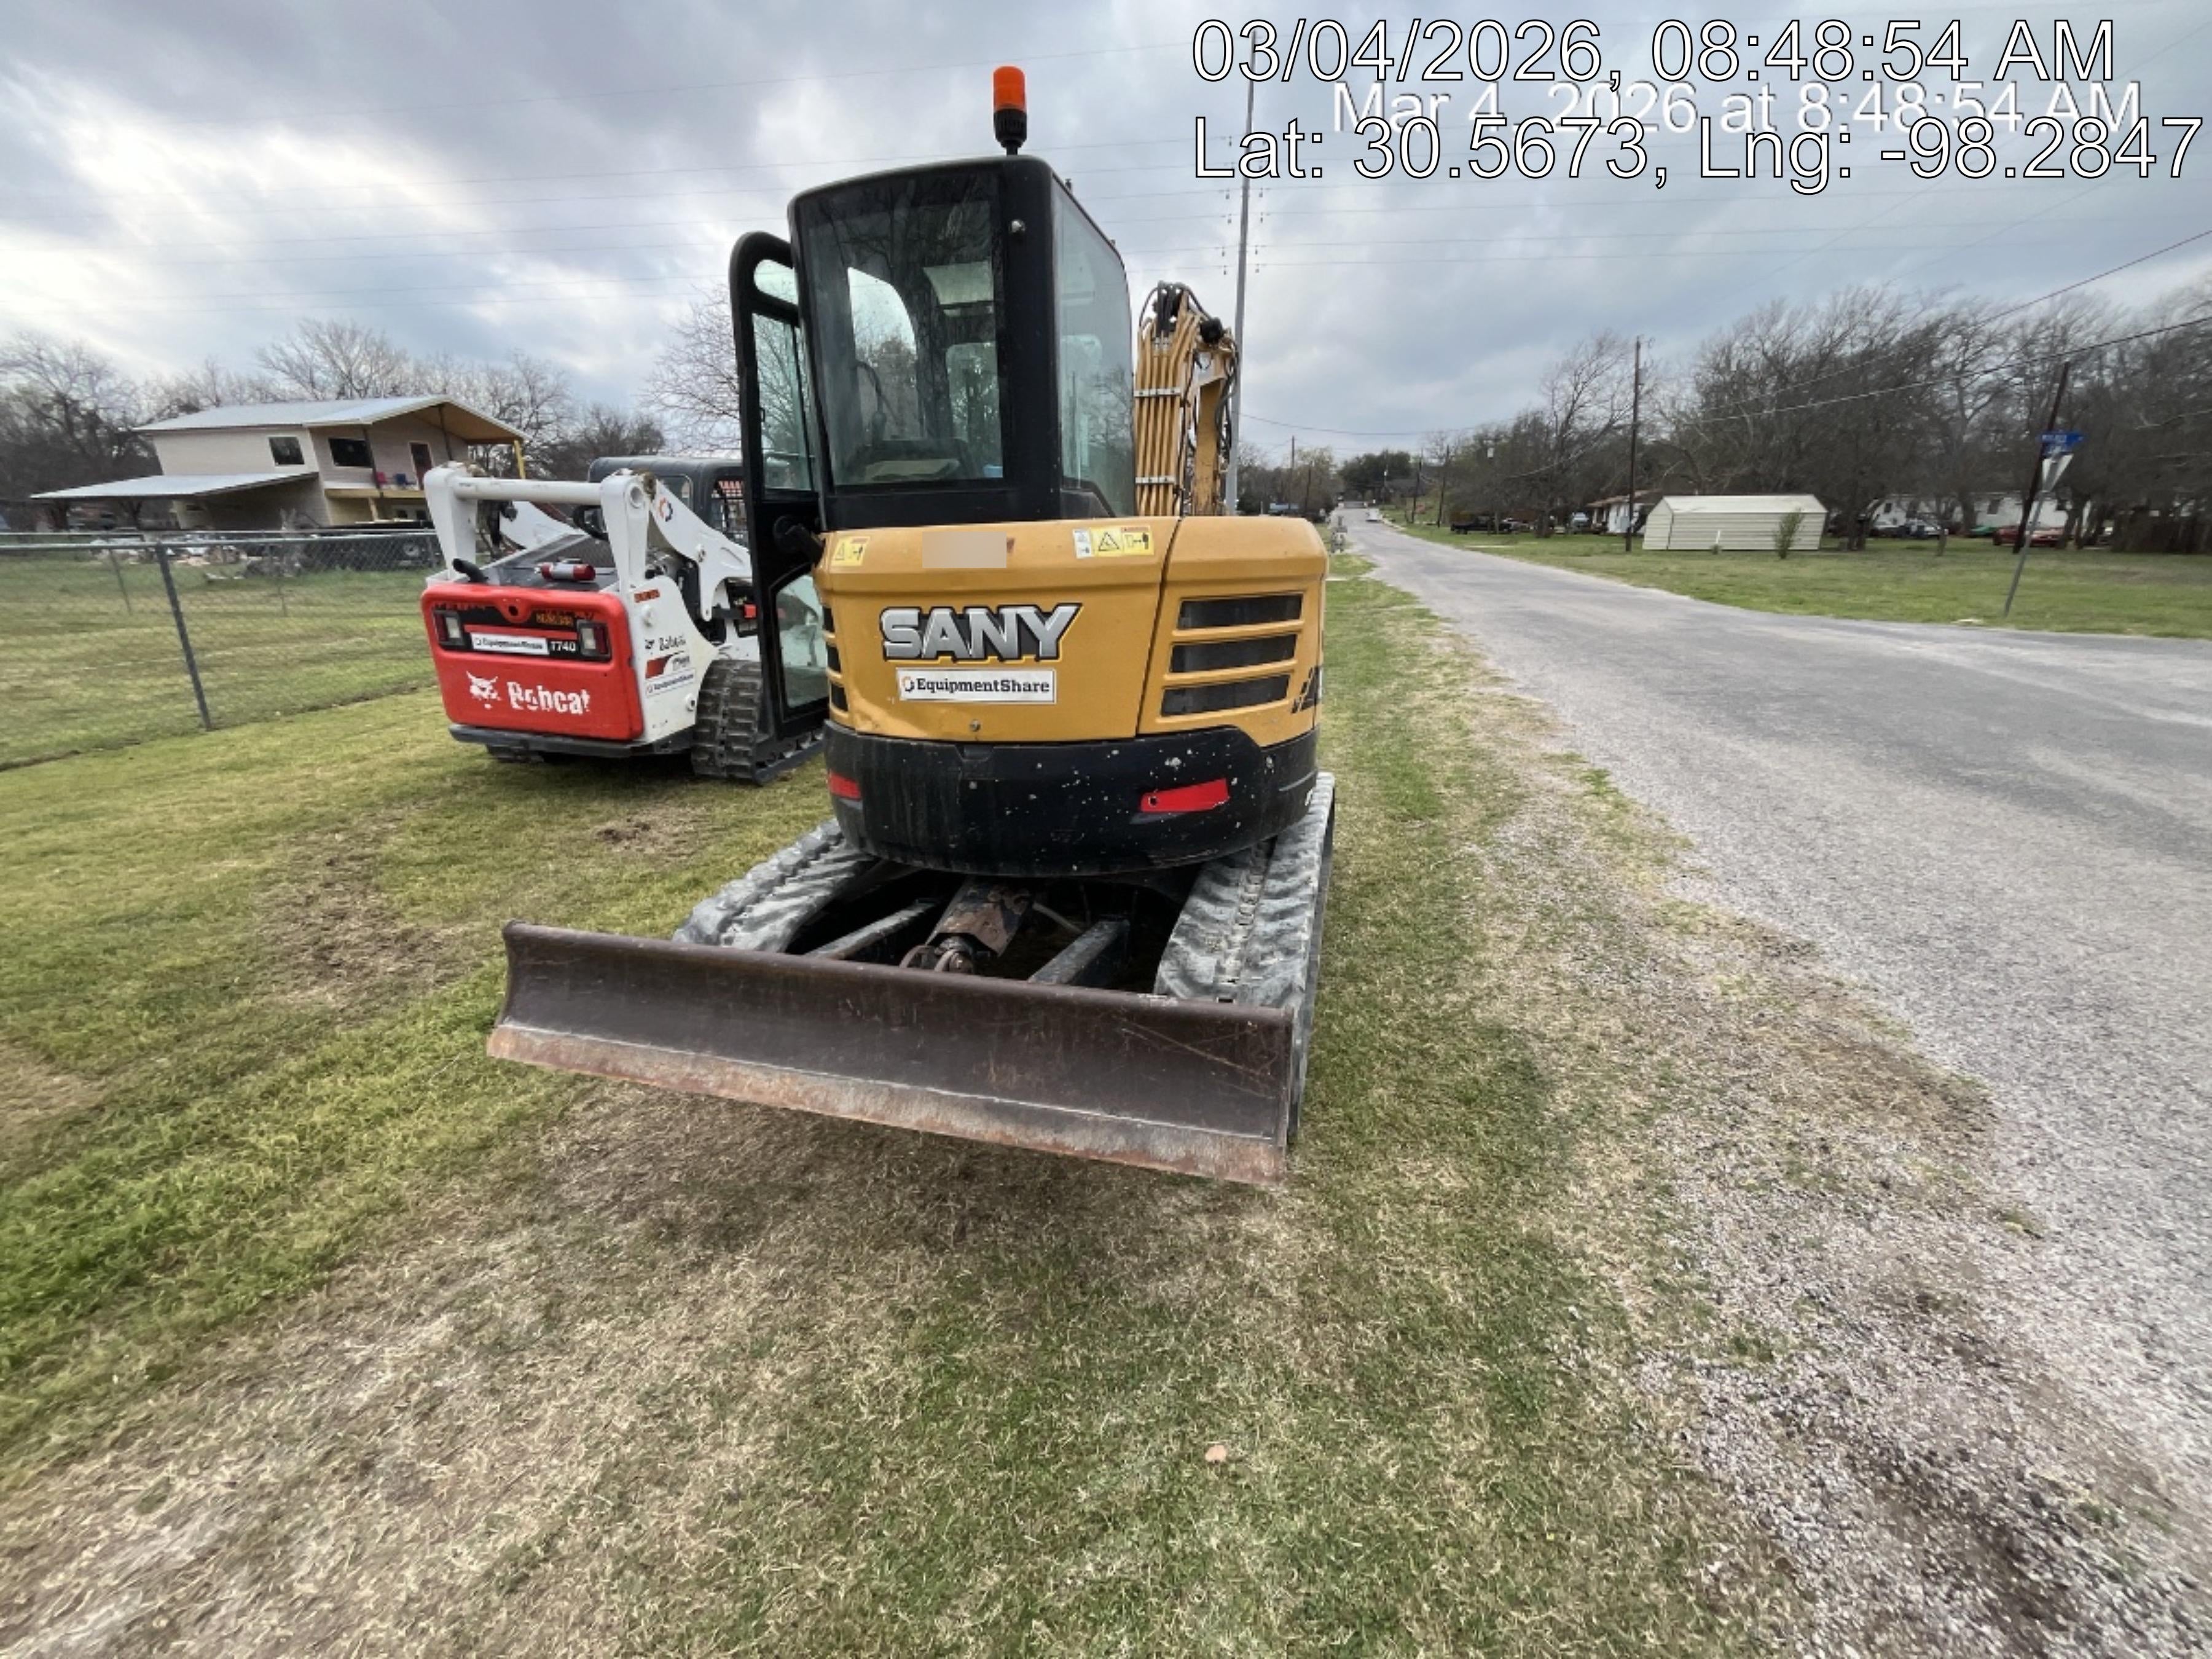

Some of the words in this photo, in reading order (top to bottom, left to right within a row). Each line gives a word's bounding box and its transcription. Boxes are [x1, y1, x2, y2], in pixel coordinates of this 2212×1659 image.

[879, 603, 1083, 662] SANY
[551, 641, 576, 653] T740
[506, 681, 590, 715] Bobcat
[916, 677, 1050, 694] EquipmentShare
